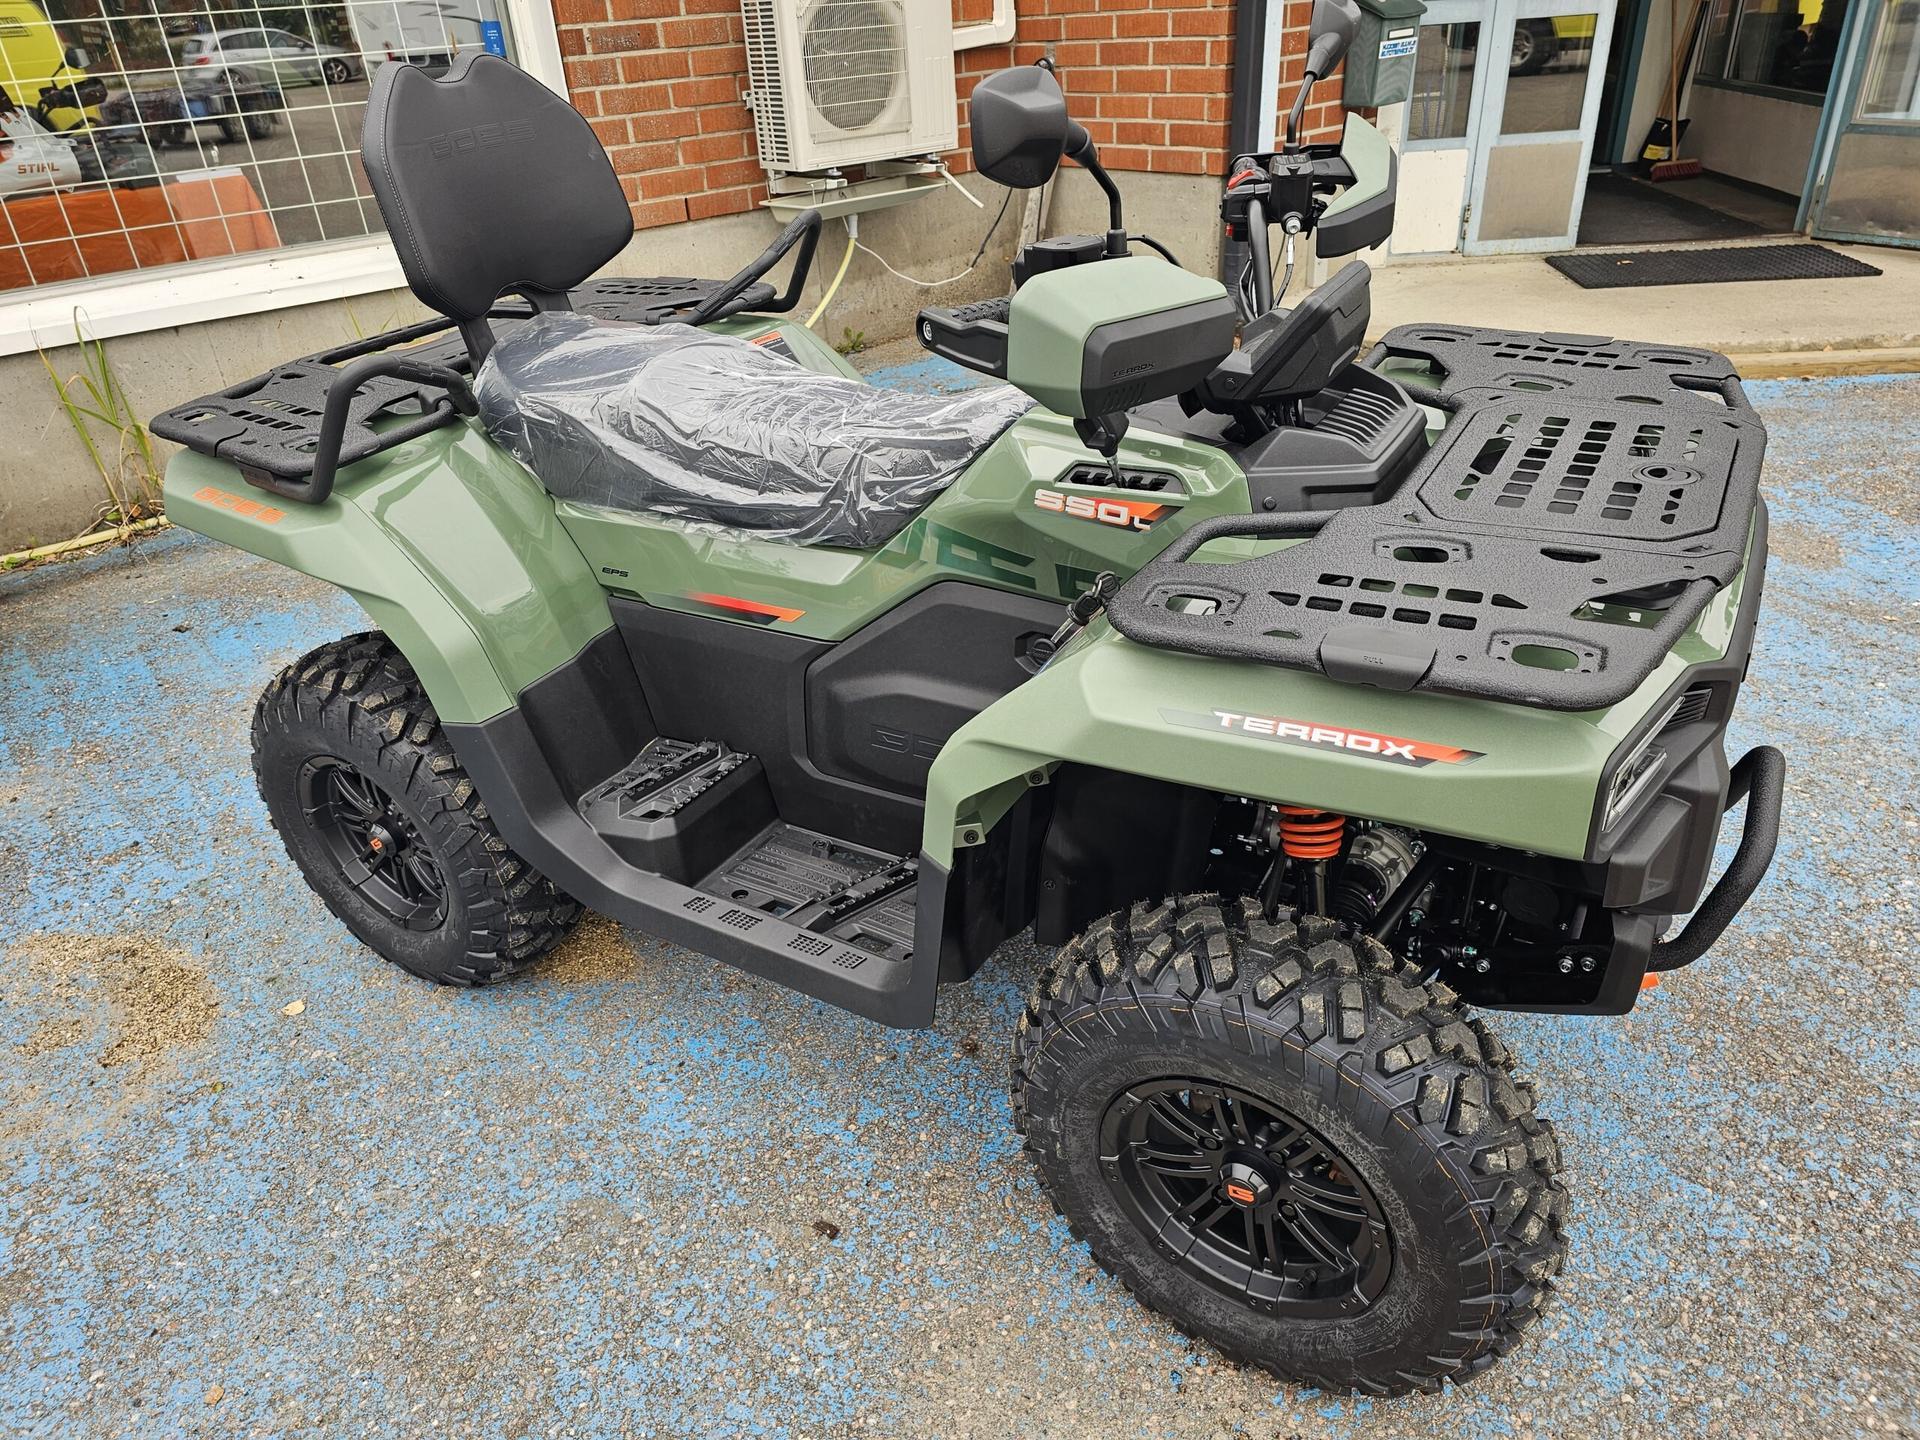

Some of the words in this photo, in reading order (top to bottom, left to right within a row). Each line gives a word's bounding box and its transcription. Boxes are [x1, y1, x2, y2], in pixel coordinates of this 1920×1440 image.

[17, 162, 60, 174] STIHL
[192, 486, 288, 526] GOES
[602, 567, 629, 578] EPS
[1213, 710, 1416, 761] TERROX
